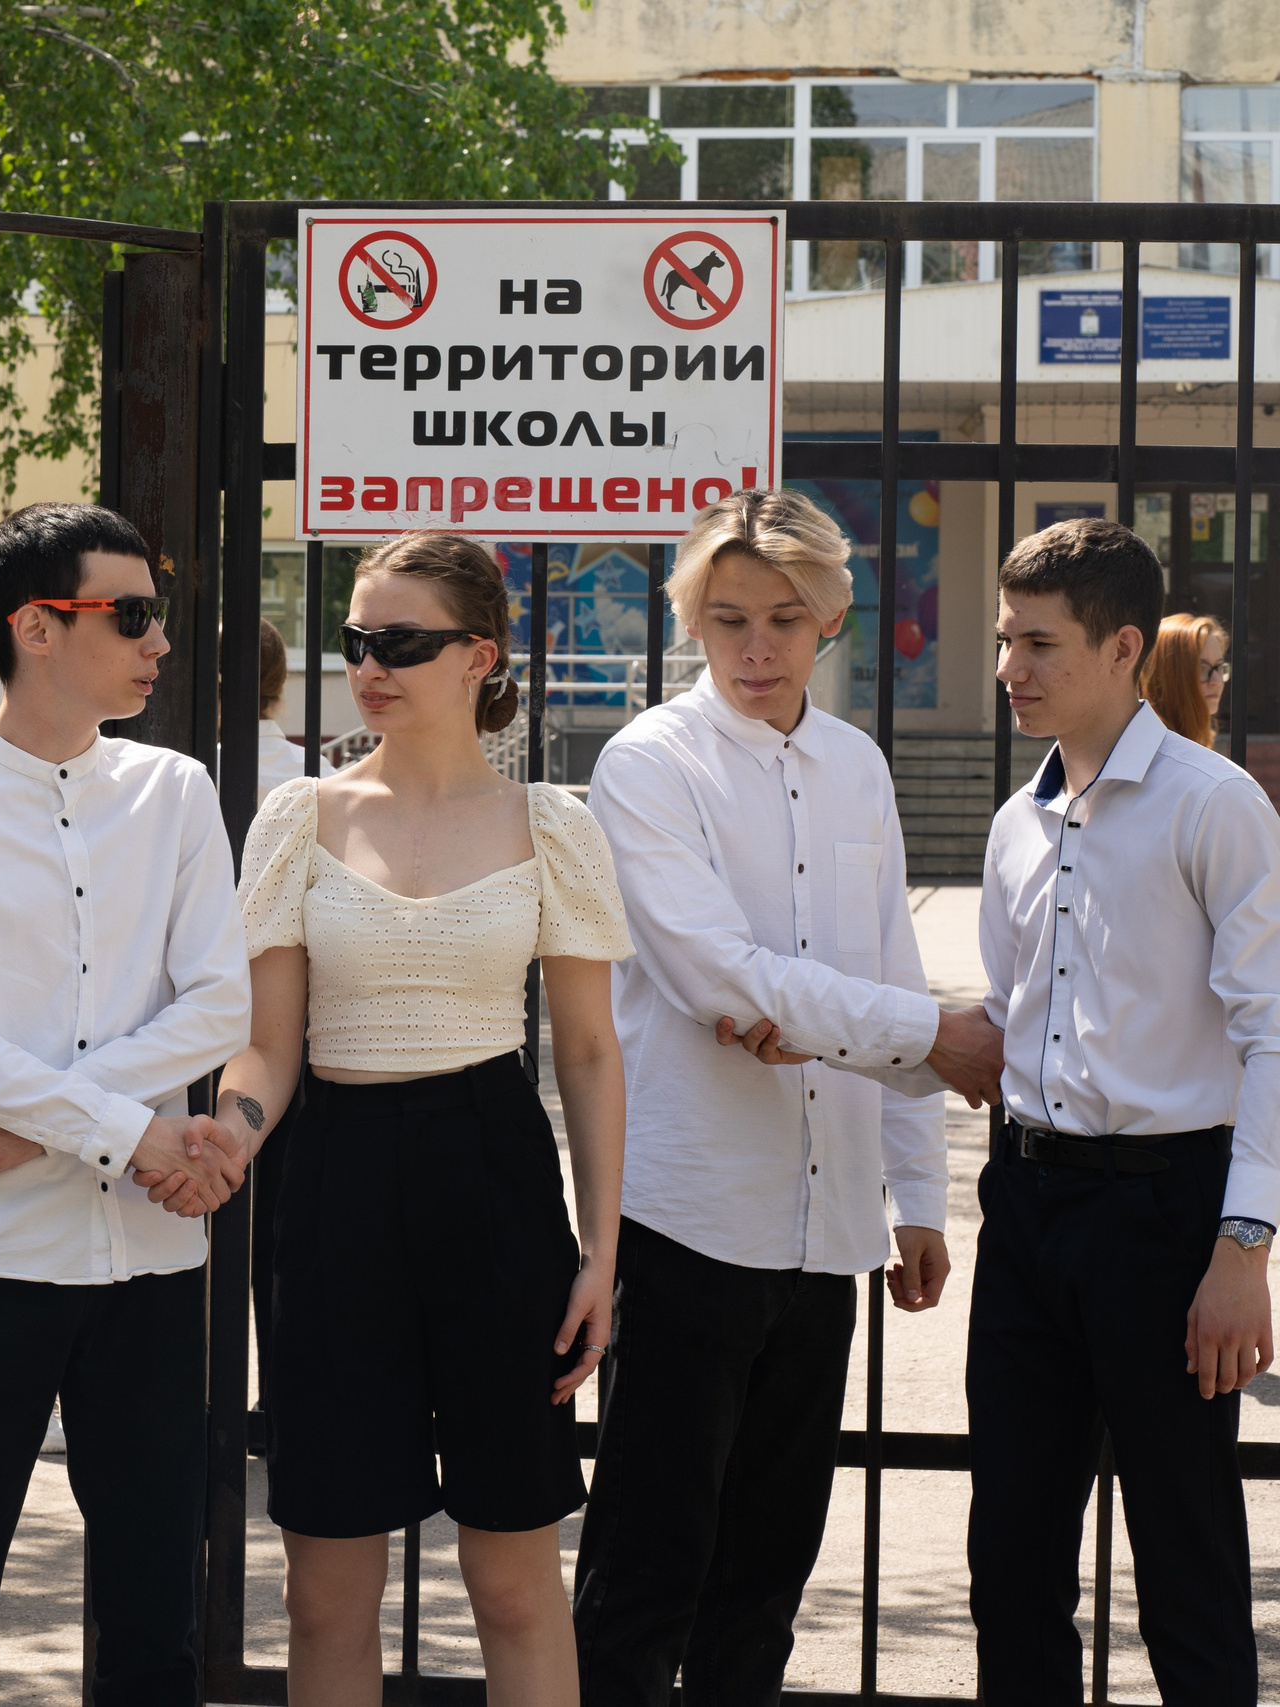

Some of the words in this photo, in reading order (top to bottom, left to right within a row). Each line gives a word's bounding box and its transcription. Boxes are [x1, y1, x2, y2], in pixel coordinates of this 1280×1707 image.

[500, 279, 582, 314] на
[316, 345, 764, 391] территории
[413, 411, 666, 446] школы
[321, 467, 757, 522] запрещено!
